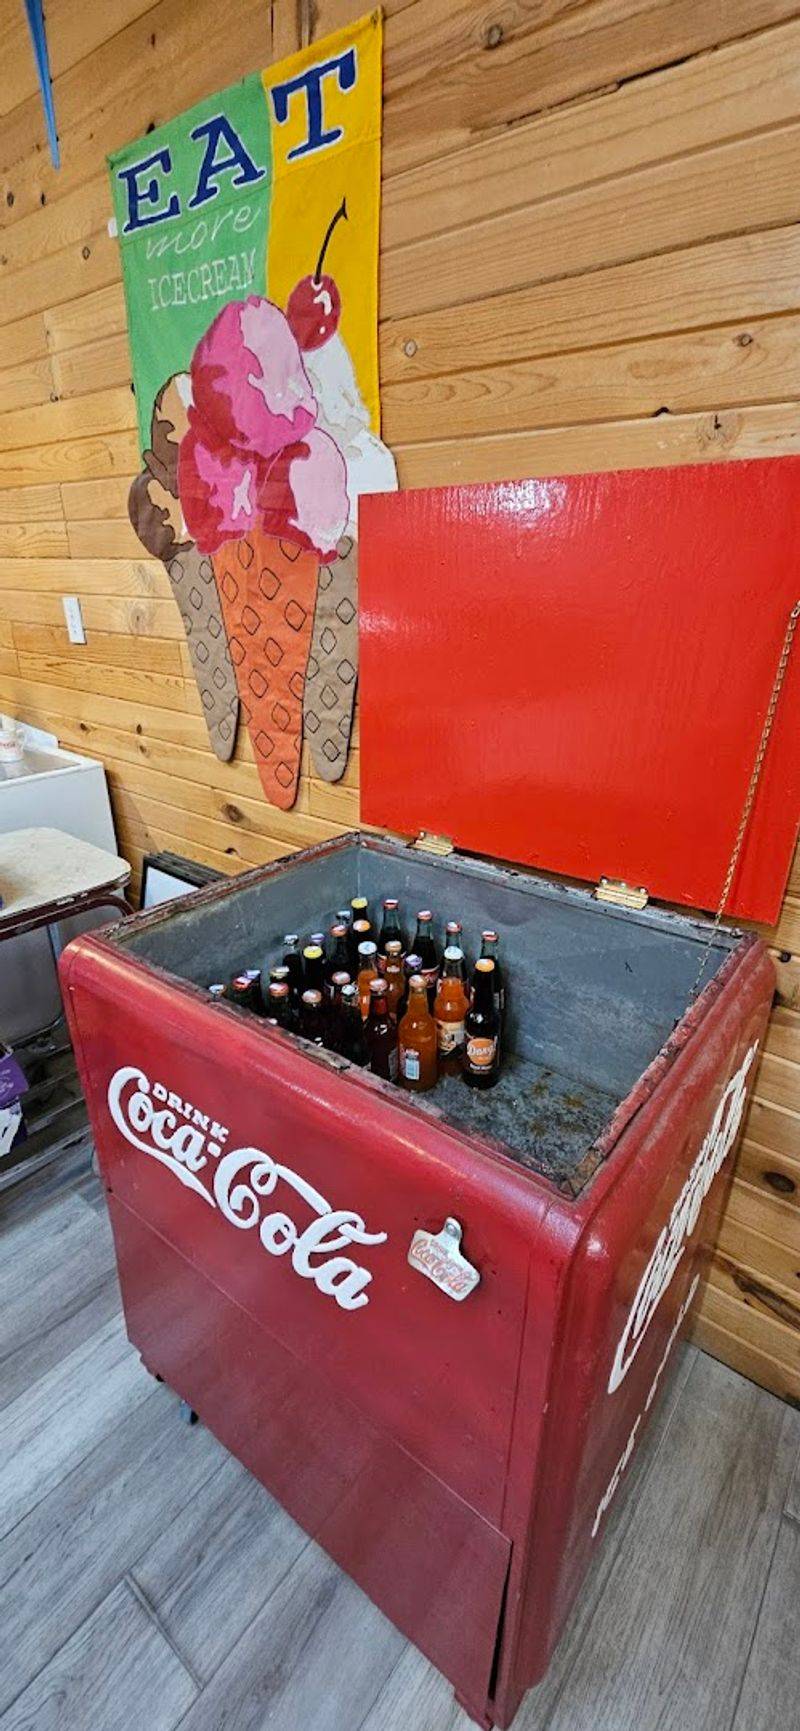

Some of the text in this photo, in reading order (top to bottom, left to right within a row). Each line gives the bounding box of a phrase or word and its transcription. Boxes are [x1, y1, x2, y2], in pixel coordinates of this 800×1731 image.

[117, 47, 358, 235] EAT
[146, 205, 261, 260] more
[147, 248, 257, 310] ICECREAM
[152, 1082, 229, 1143] DRINK
[107, 1066, 388, 1310] Coca-Cola
